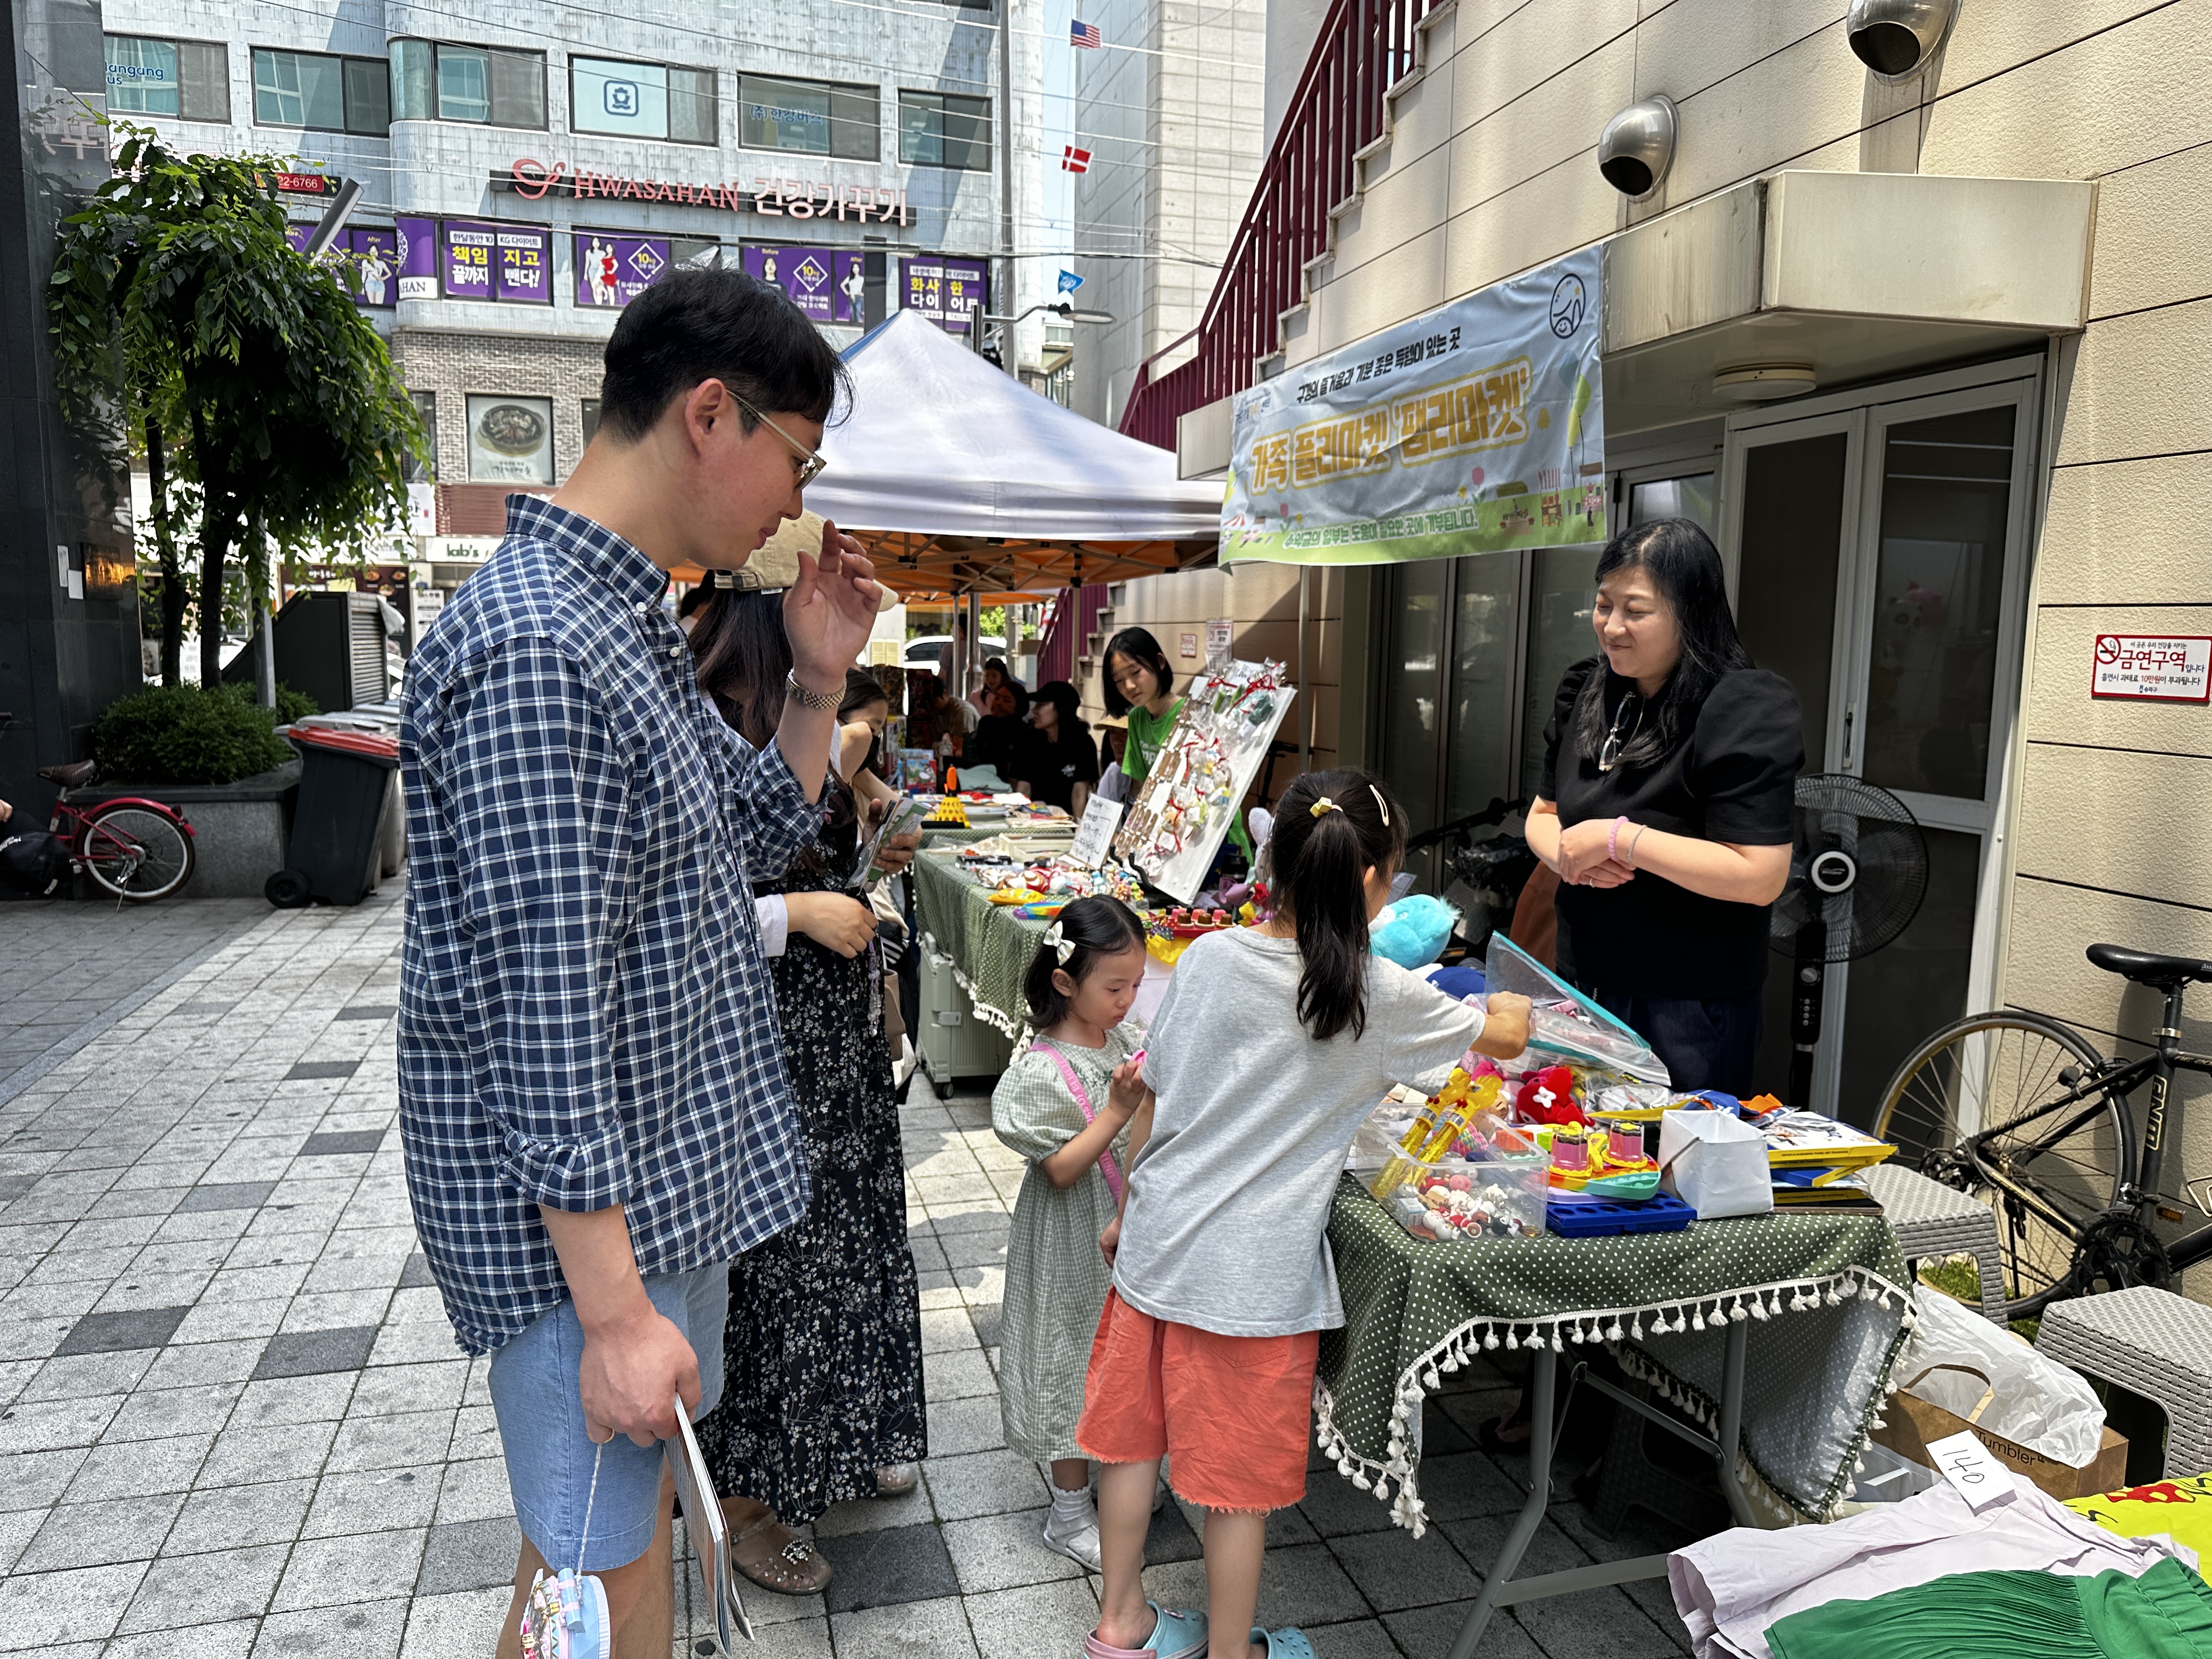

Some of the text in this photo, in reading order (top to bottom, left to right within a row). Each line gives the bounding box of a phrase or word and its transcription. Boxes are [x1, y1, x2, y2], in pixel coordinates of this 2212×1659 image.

[107, 76, 122, 85] us
[771, 108, 822, 124] 한강버스
[278, 176, 318, 189] 22-6766
[573, 168, 906, 227] HWASAHAN 건강가꾸기
[453, 233, 483, 244] 한달동안
[511, 237, 538, 246] 다이어트
[452, 246, 488, 264] 책임
[504, 249, 540, 267] 지고
[452, 264, 489, 285] 끝까지
[504, 267, 540, 287] 뺀다!
[911, 277, 940, 294] 화사
[950, 281, 963, 295] 한
[911, 294, 939, 309] 다이
[1297, 379, 1320, 403] 구경의
[1319, 368, 1354, 396] 즐거움과
[1356, 360, 1374, 383] 기분
[1373, 353, 1394, 378] 좋은
[1395, 340, 1424, 369] 득템이
[1426, 333, 1447, 360] 있는
[1449, 326, 1461, 351] 곳
[1252, 438, 1288, 487] 가족
[1296, 410, 1387, 483] 플리마켓
[1285, 530, 1321, 548] 수익금의
[1322, 526, 1349, 545] 일부는
[1352, 522, 1378, 541] 도움이
[1379, 519, 1405, 538] 필요한
[1406, 516, 1425, 535] 곳에
[447, 544, 479, 557] kab's
[2101, 673, 2200, 686] 흡연시 과태료 10만원이 부과됩니다
[1976, 1429, 2036, 1466] Tumbler
[1942, 1449, 1984, 1484] 140
